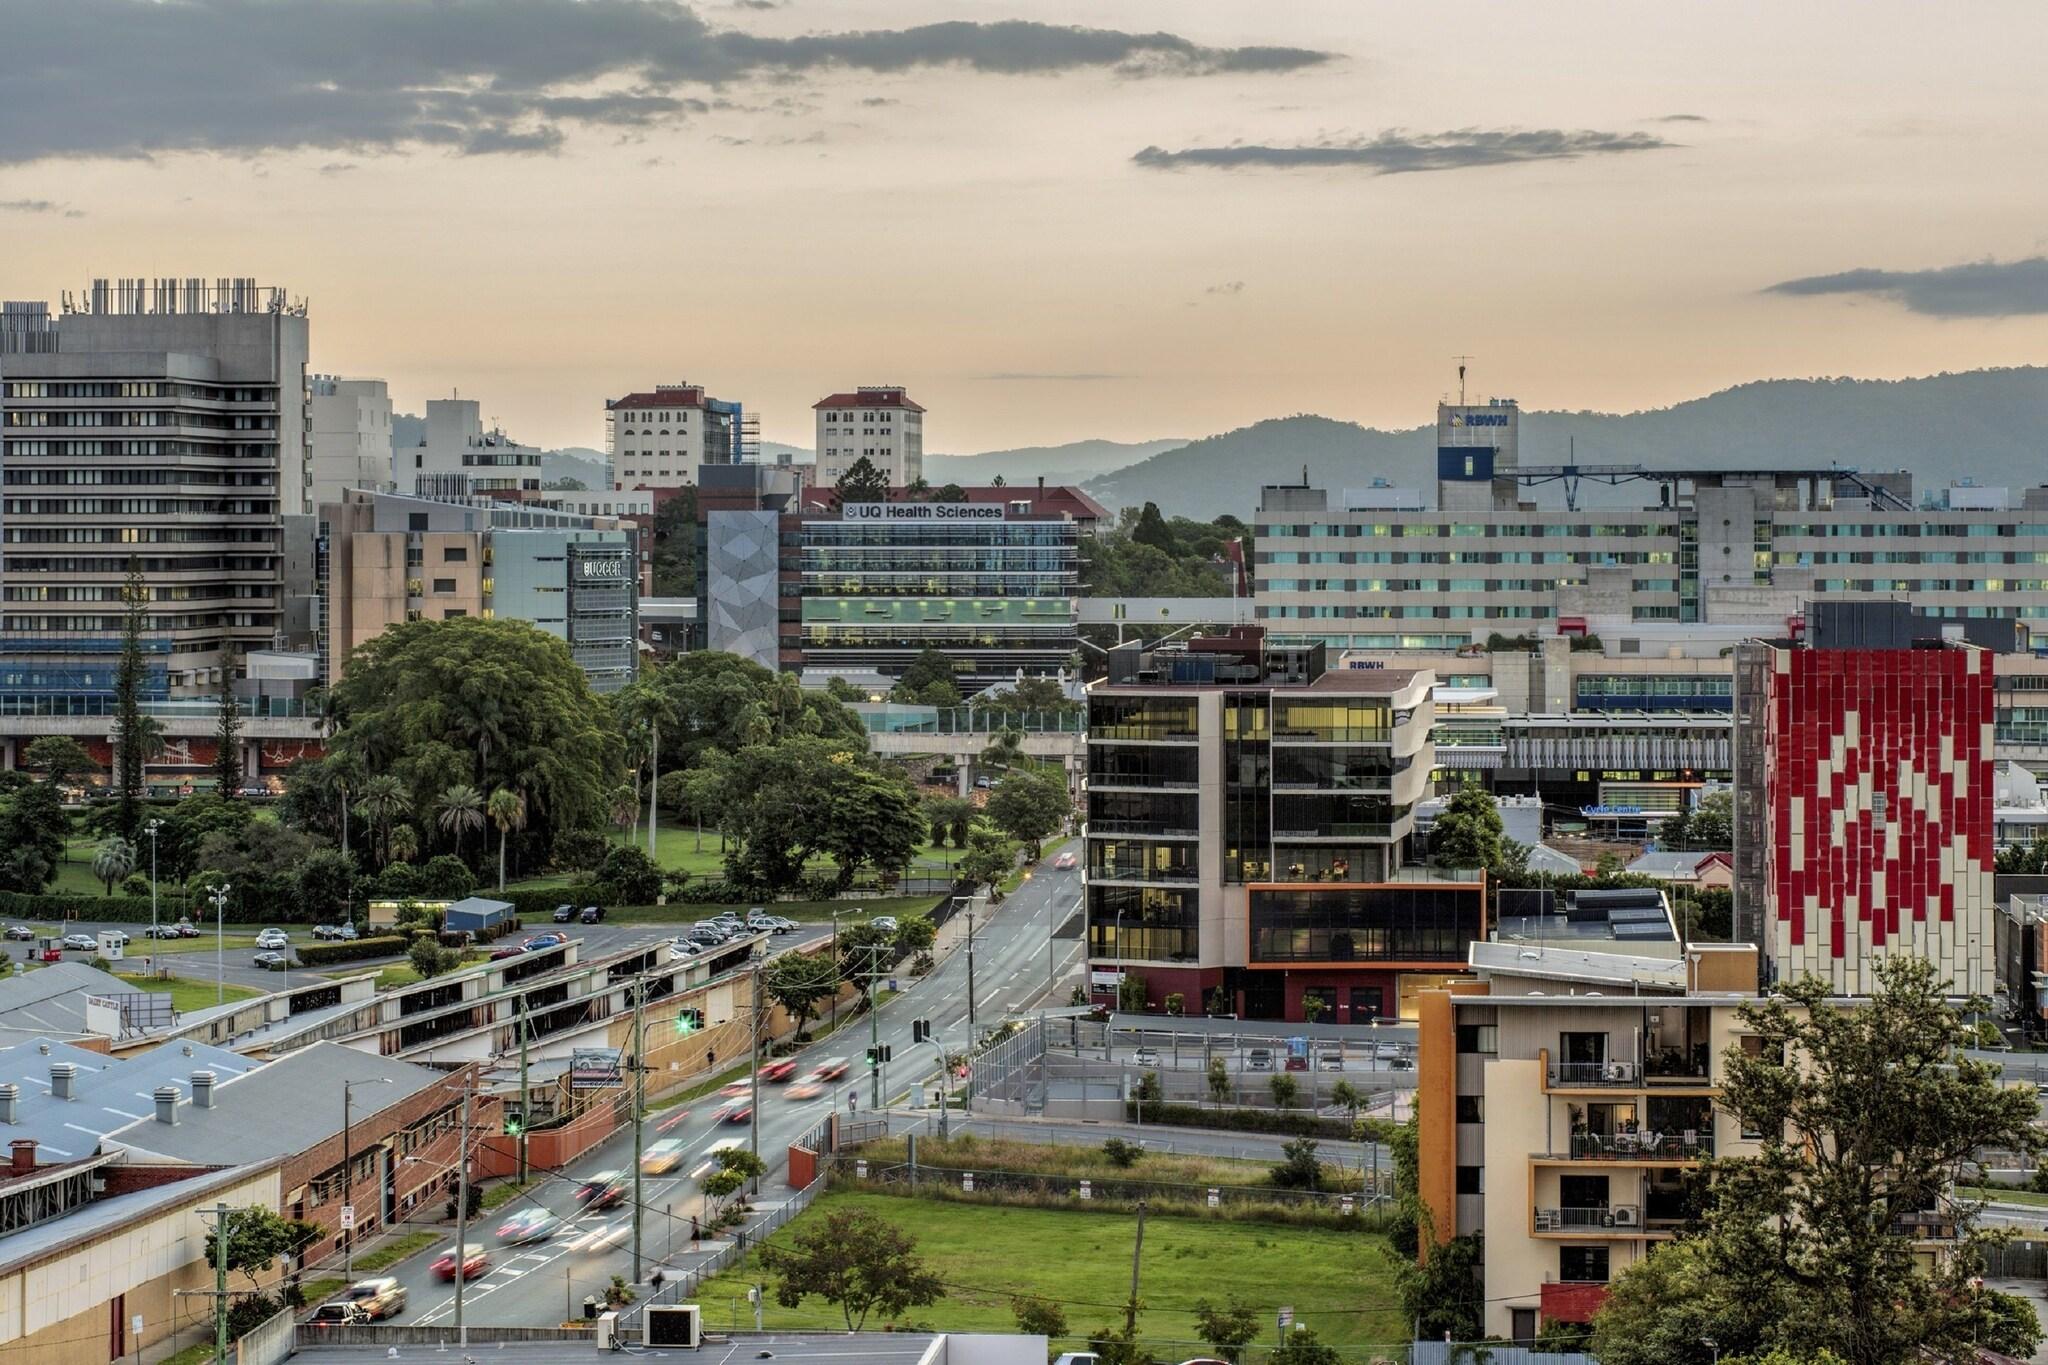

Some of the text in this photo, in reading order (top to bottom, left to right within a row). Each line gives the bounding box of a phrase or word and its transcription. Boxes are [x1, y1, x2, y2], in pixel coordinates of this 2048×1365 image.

[1465, 414, 1508, 426] RBWH
[859, 505, 1003, 518] UQ Health Sciences
[1349, 661, 1384, 669] RBWH
[1585, 804, 1641, 814] Cycle Centre
